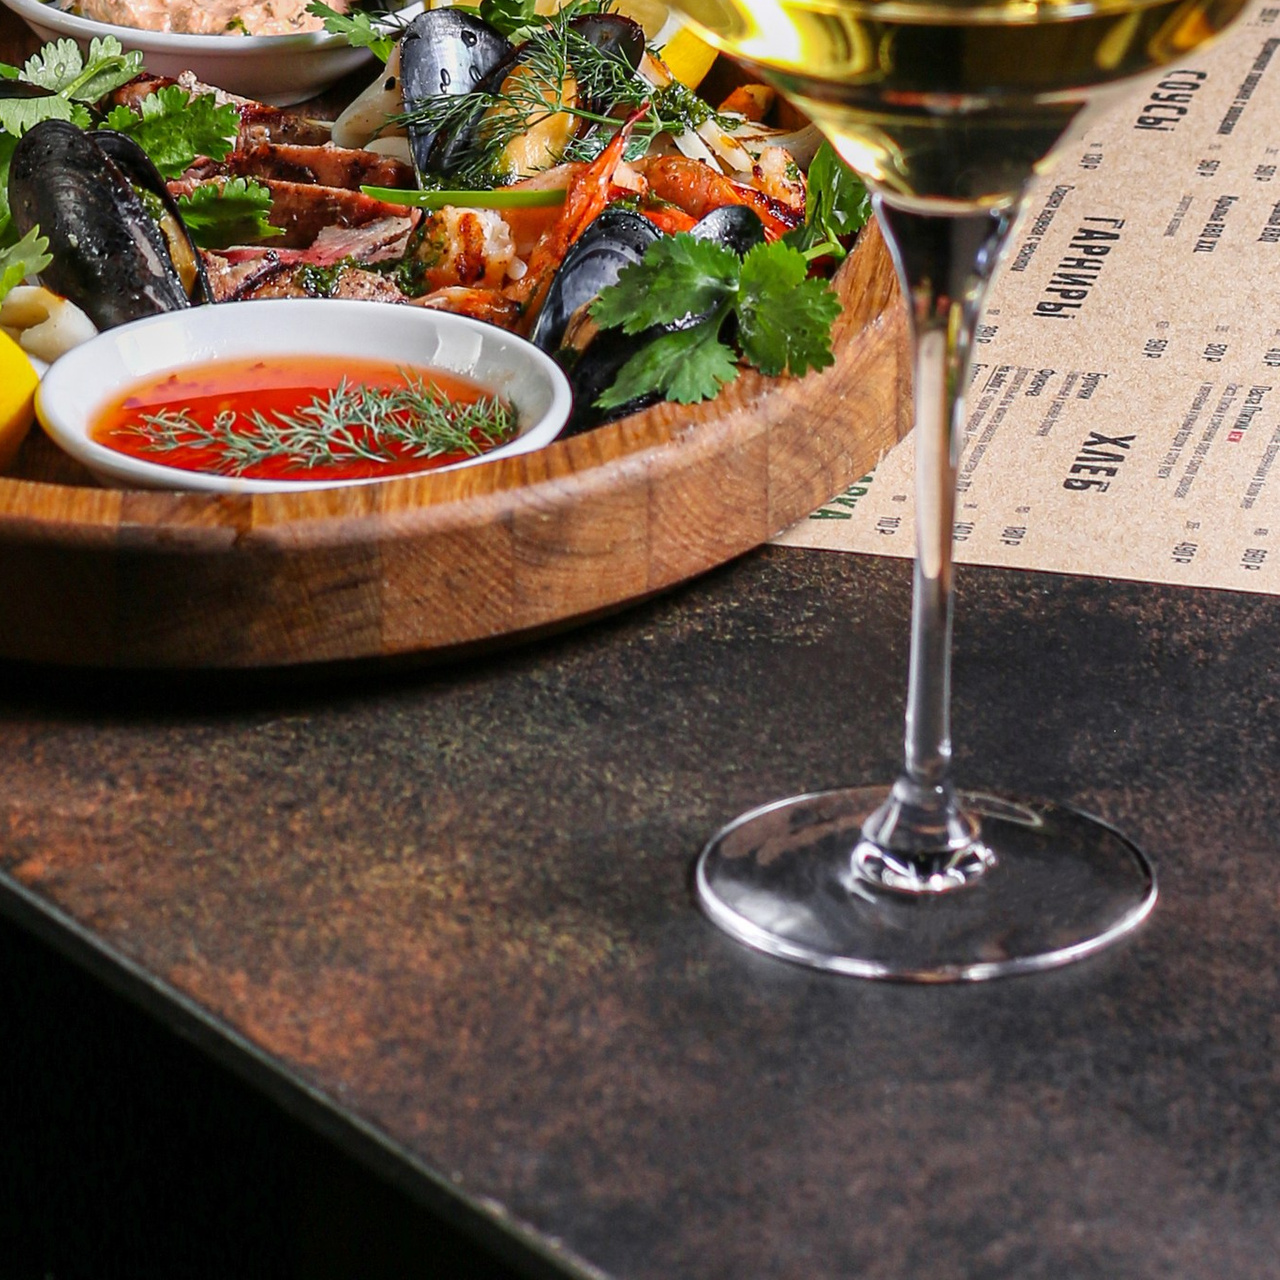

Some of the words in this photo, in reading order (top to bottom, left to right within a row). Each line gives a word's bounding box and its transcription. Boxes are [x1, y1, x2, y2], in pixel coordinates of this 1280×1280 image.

[1134, 70, 1209, 132] СОУСЫ
[1209, 195, 1240, 222] Крылья
[1199, 223, 1226, 238] BBQ
[1193, 239, 1217, 253] XXL
[1033, 217, 1126, 320] ГАРНИРЫ
[1024, 368, 1058, 397] Фокачча
[1076, 371, 1108, 399] Булочки
[1246, 385, 1273, 405] Паста
[1063, 431, 1137, 493] ХЛЕБ
